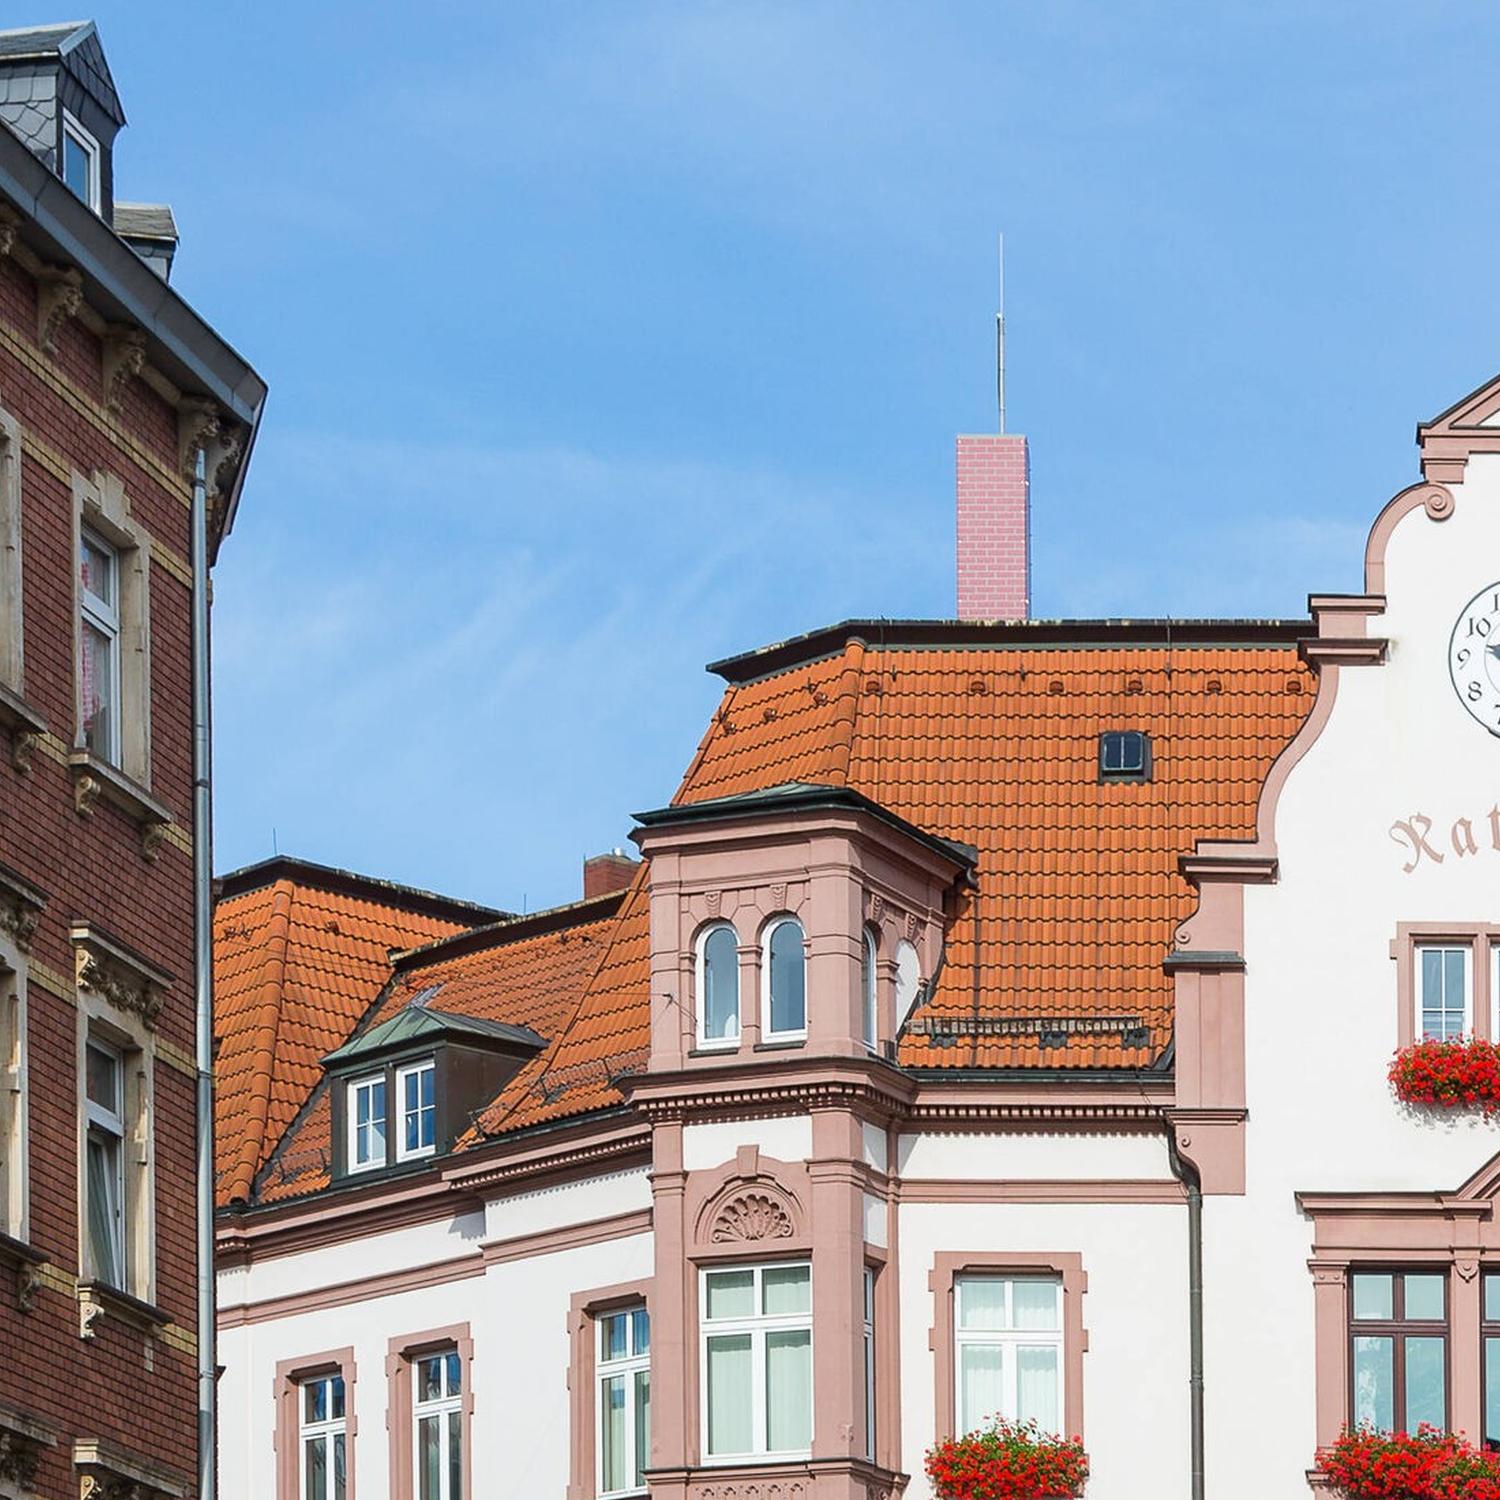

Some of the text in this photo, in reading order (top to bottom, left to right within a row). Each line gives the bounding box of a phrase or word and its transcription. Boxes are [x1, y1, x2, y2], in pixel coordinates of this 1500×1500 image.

[1466, 617, 1491, 638] 10
[1457, 648, 1471, 670] 9
[1468, 681, 1482, 702] 8
